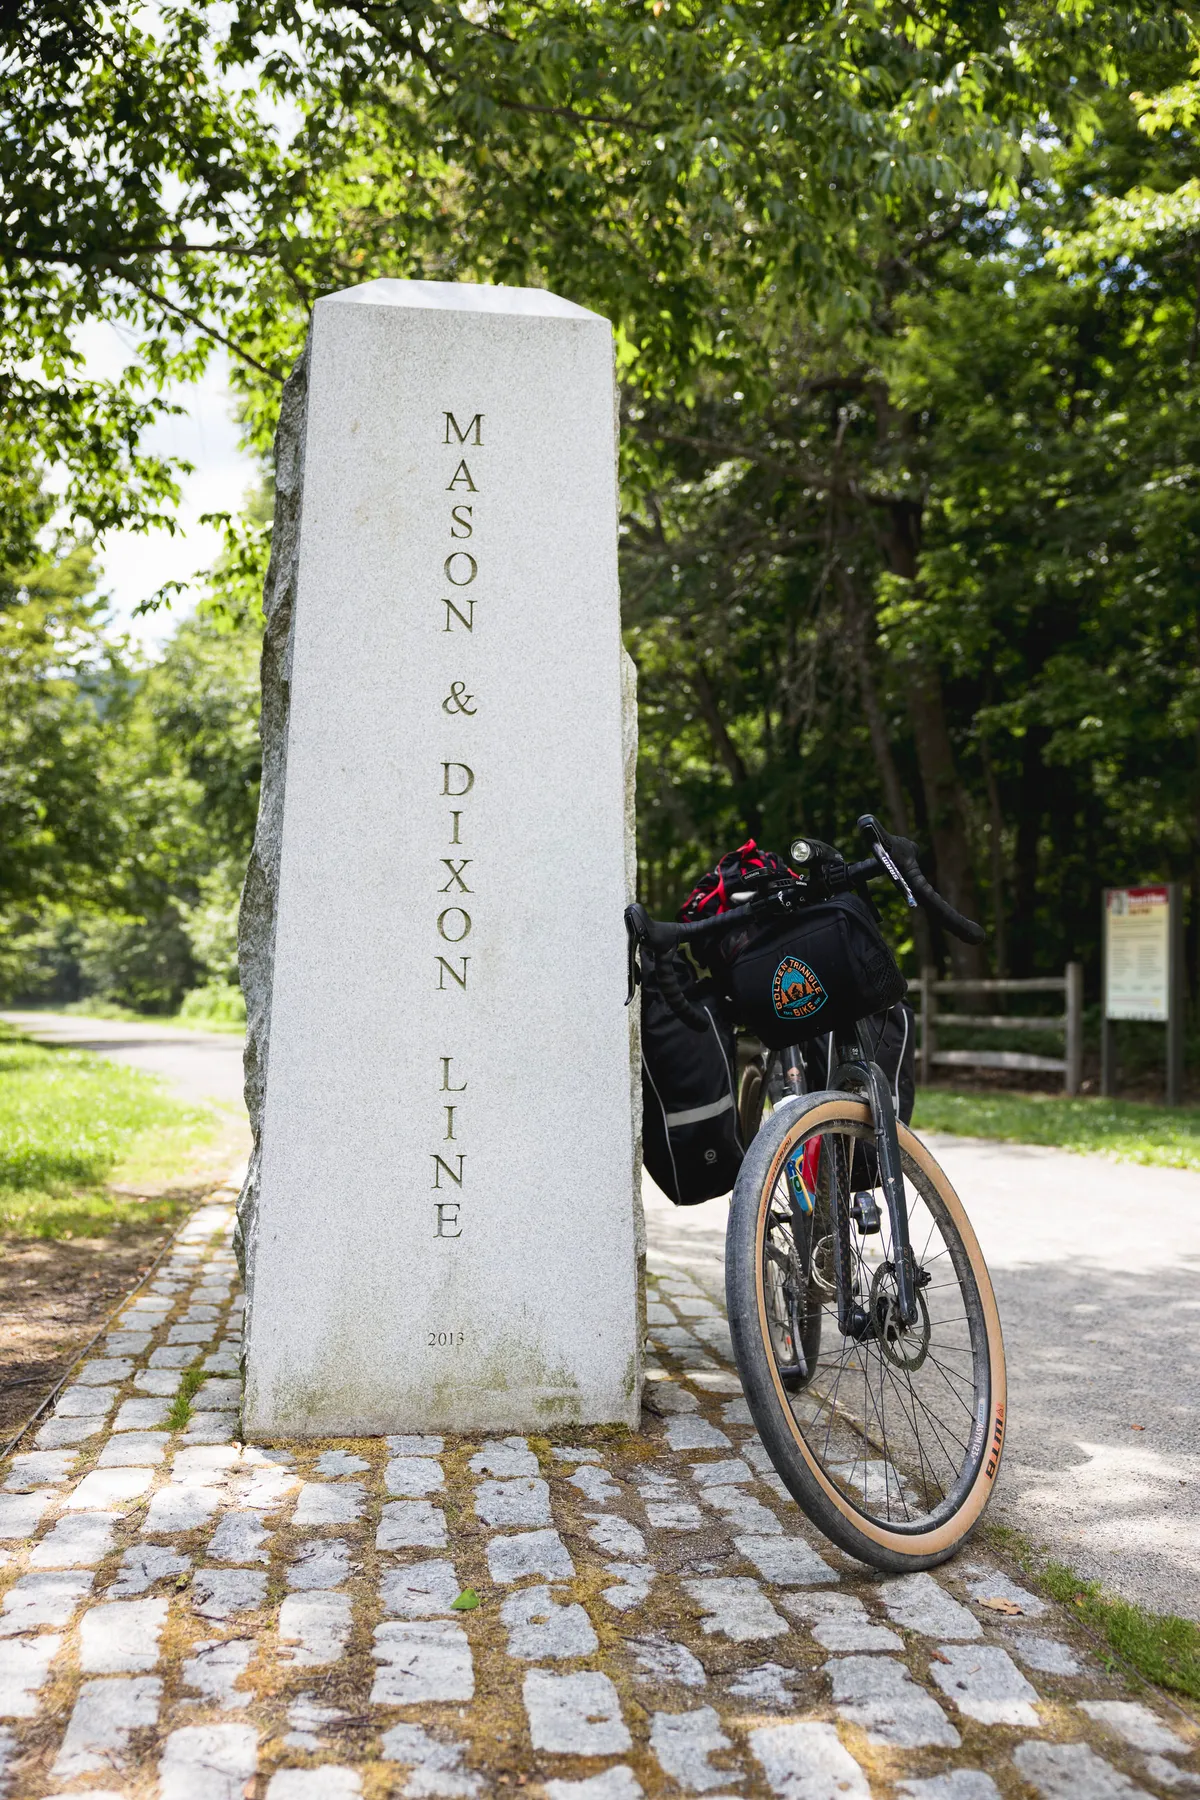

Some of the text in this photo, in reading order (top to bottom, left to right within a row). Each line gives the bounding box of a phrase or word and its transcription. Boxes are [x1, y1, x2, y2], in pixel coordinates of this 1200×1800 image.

[429, 411, 485, 1238] MASON & DIXON LINE
[774, 959, 822, 1010] GOLDEN TRIANGLE
[793, 1001, 816, 1017] BIKE
[427, 1331, 465, 1346] 2013
[986, 1418, 1002, 1479] WTB
